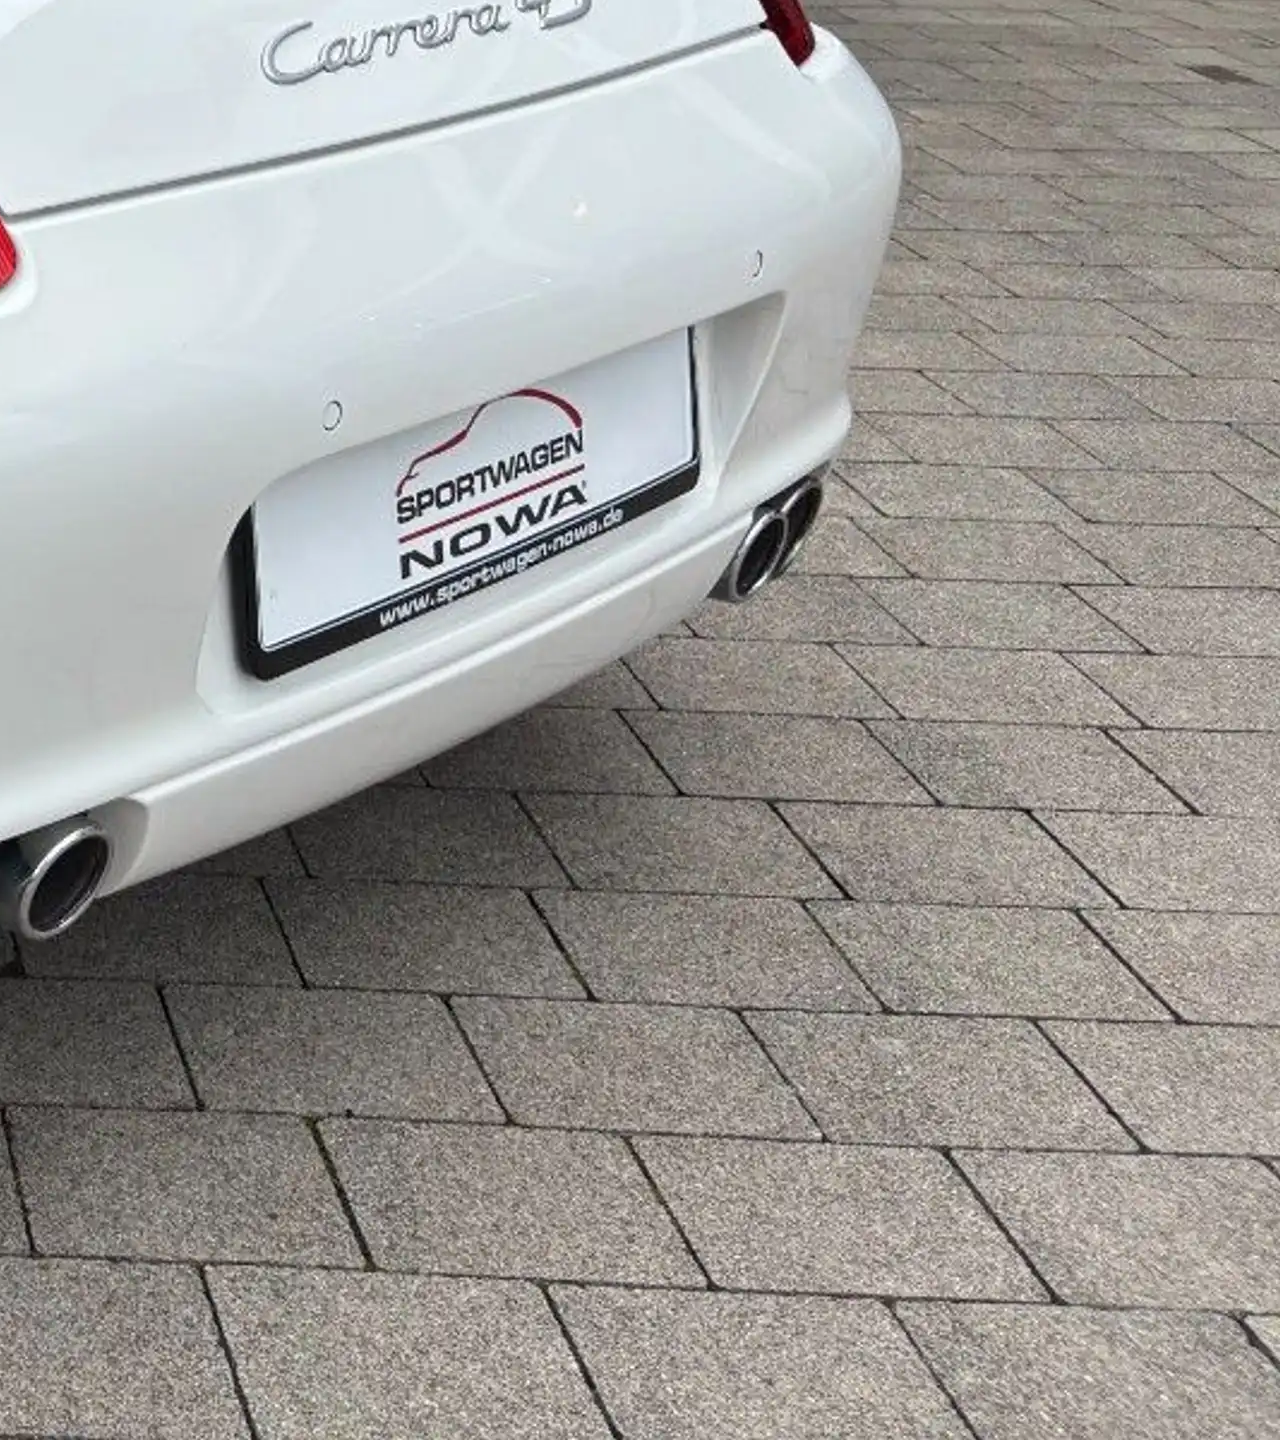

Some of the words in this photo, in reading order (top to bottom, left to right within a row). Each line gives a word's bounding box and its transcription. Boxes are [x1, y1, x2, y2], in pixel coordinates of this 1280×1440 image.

[260, 3, 513, 87] Carrera
[396, 429, 584, 525] SPORTWAGEN
[379, 507, 625, 627] www.sportwagen-nowa.de
[399, 484, 588, 580] NOWA
